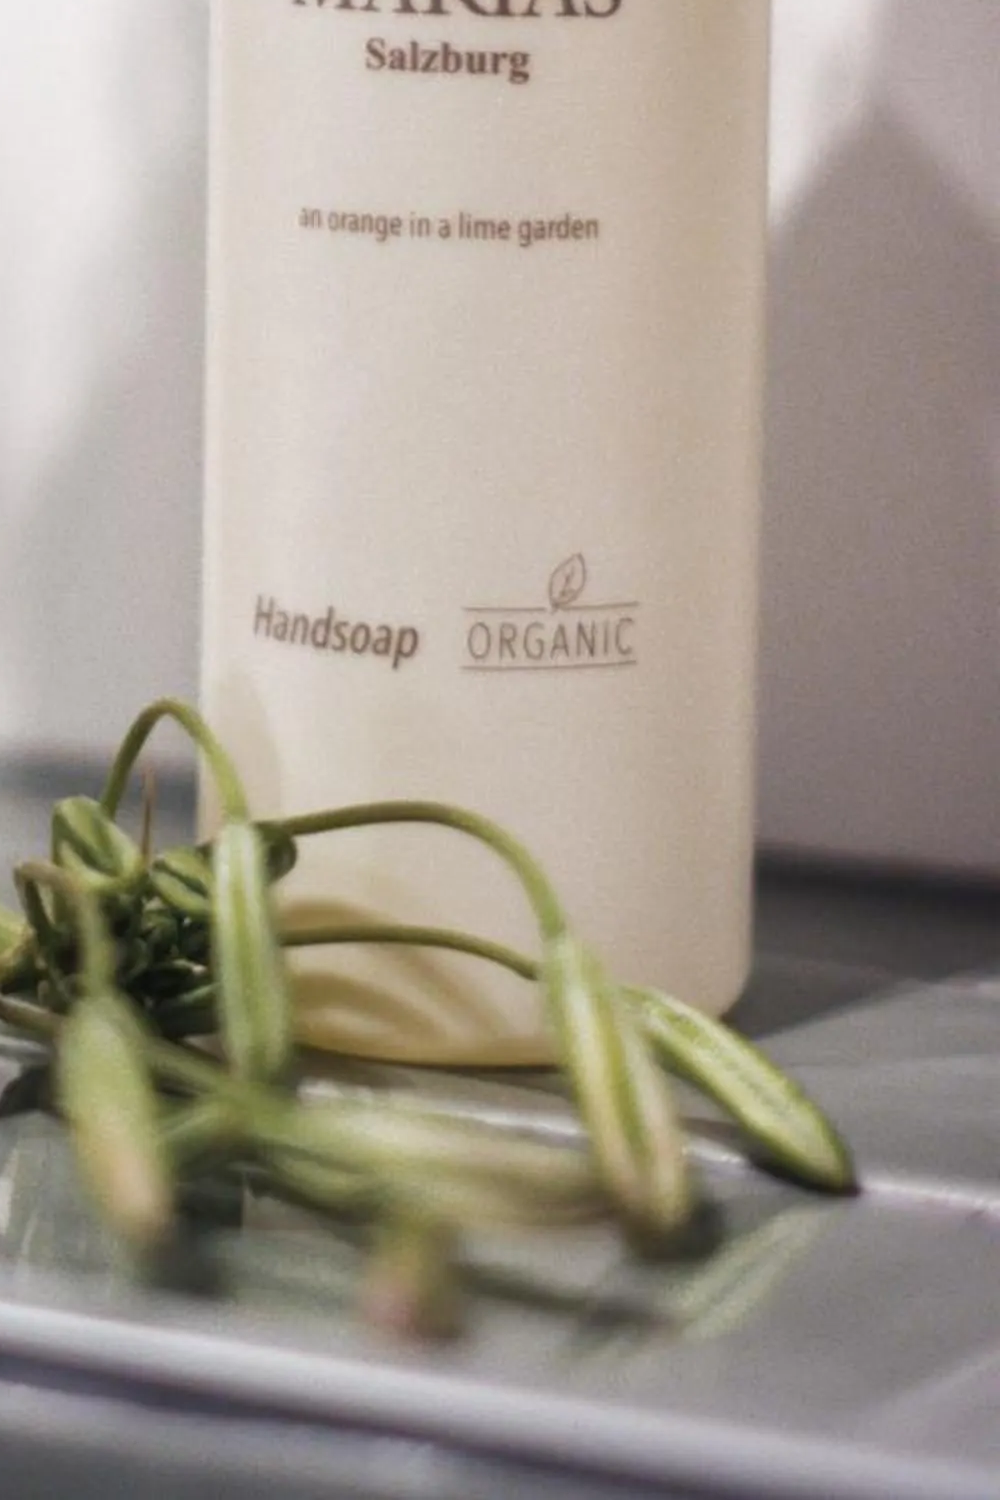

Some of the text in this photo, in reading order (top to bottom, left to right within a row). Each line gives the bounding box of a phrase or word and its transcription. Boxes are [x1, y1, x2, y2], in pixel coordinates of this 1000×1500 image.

[365, 38, 529, 83] Salzburg
[299, 207, 599, 247] an orange in a lime garden
[253, 594, 419, 671] Handsoap
[467, 617, 635, 660] ORGANIC
